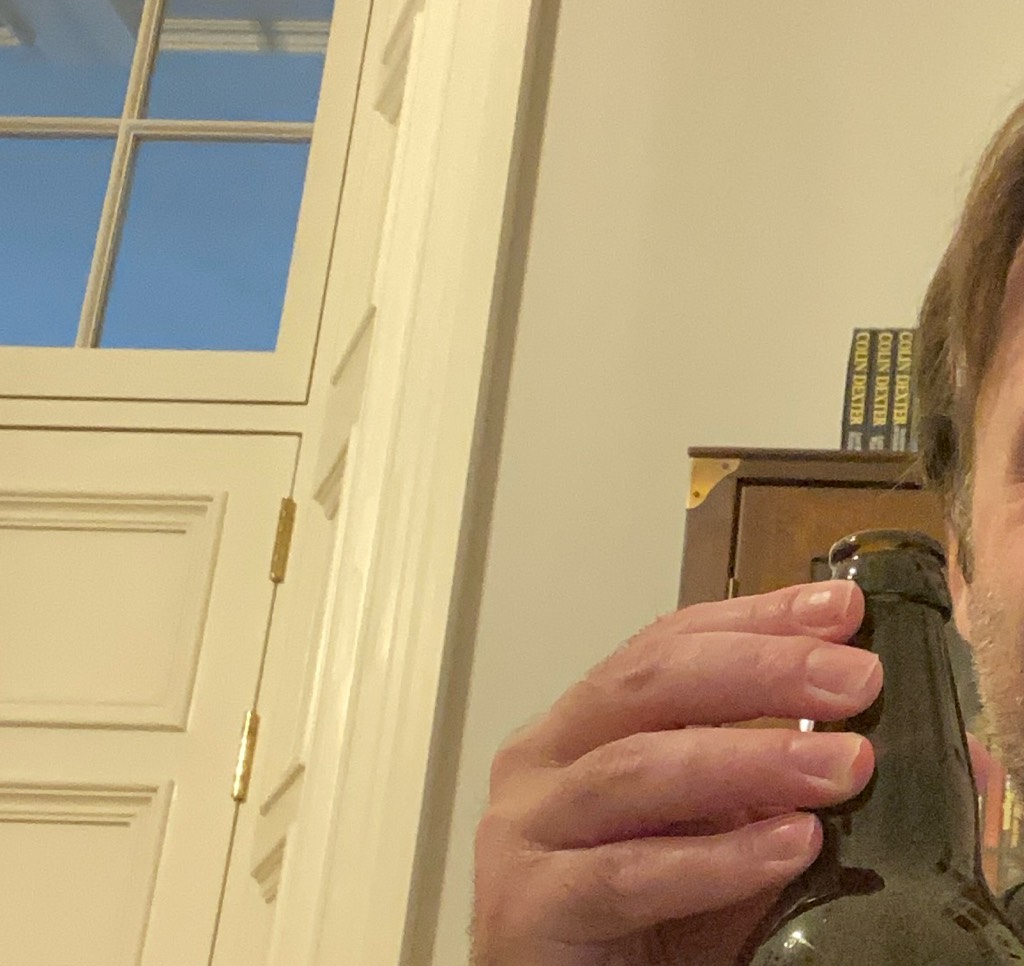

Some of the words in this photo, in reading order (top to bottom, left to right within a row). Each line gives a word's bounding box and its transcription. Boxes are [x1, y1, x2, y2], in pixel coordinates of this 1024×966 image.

[854, 331, 870, 373] COLIN
[877, 332, 893, 373] COLIN
[897, 331, 913, 373] COLIN
[850, 375, 867, 425] DEXTER
[873, 376, 890, 426] DEXTER
[893, 375, 910, 425] DEXTER
